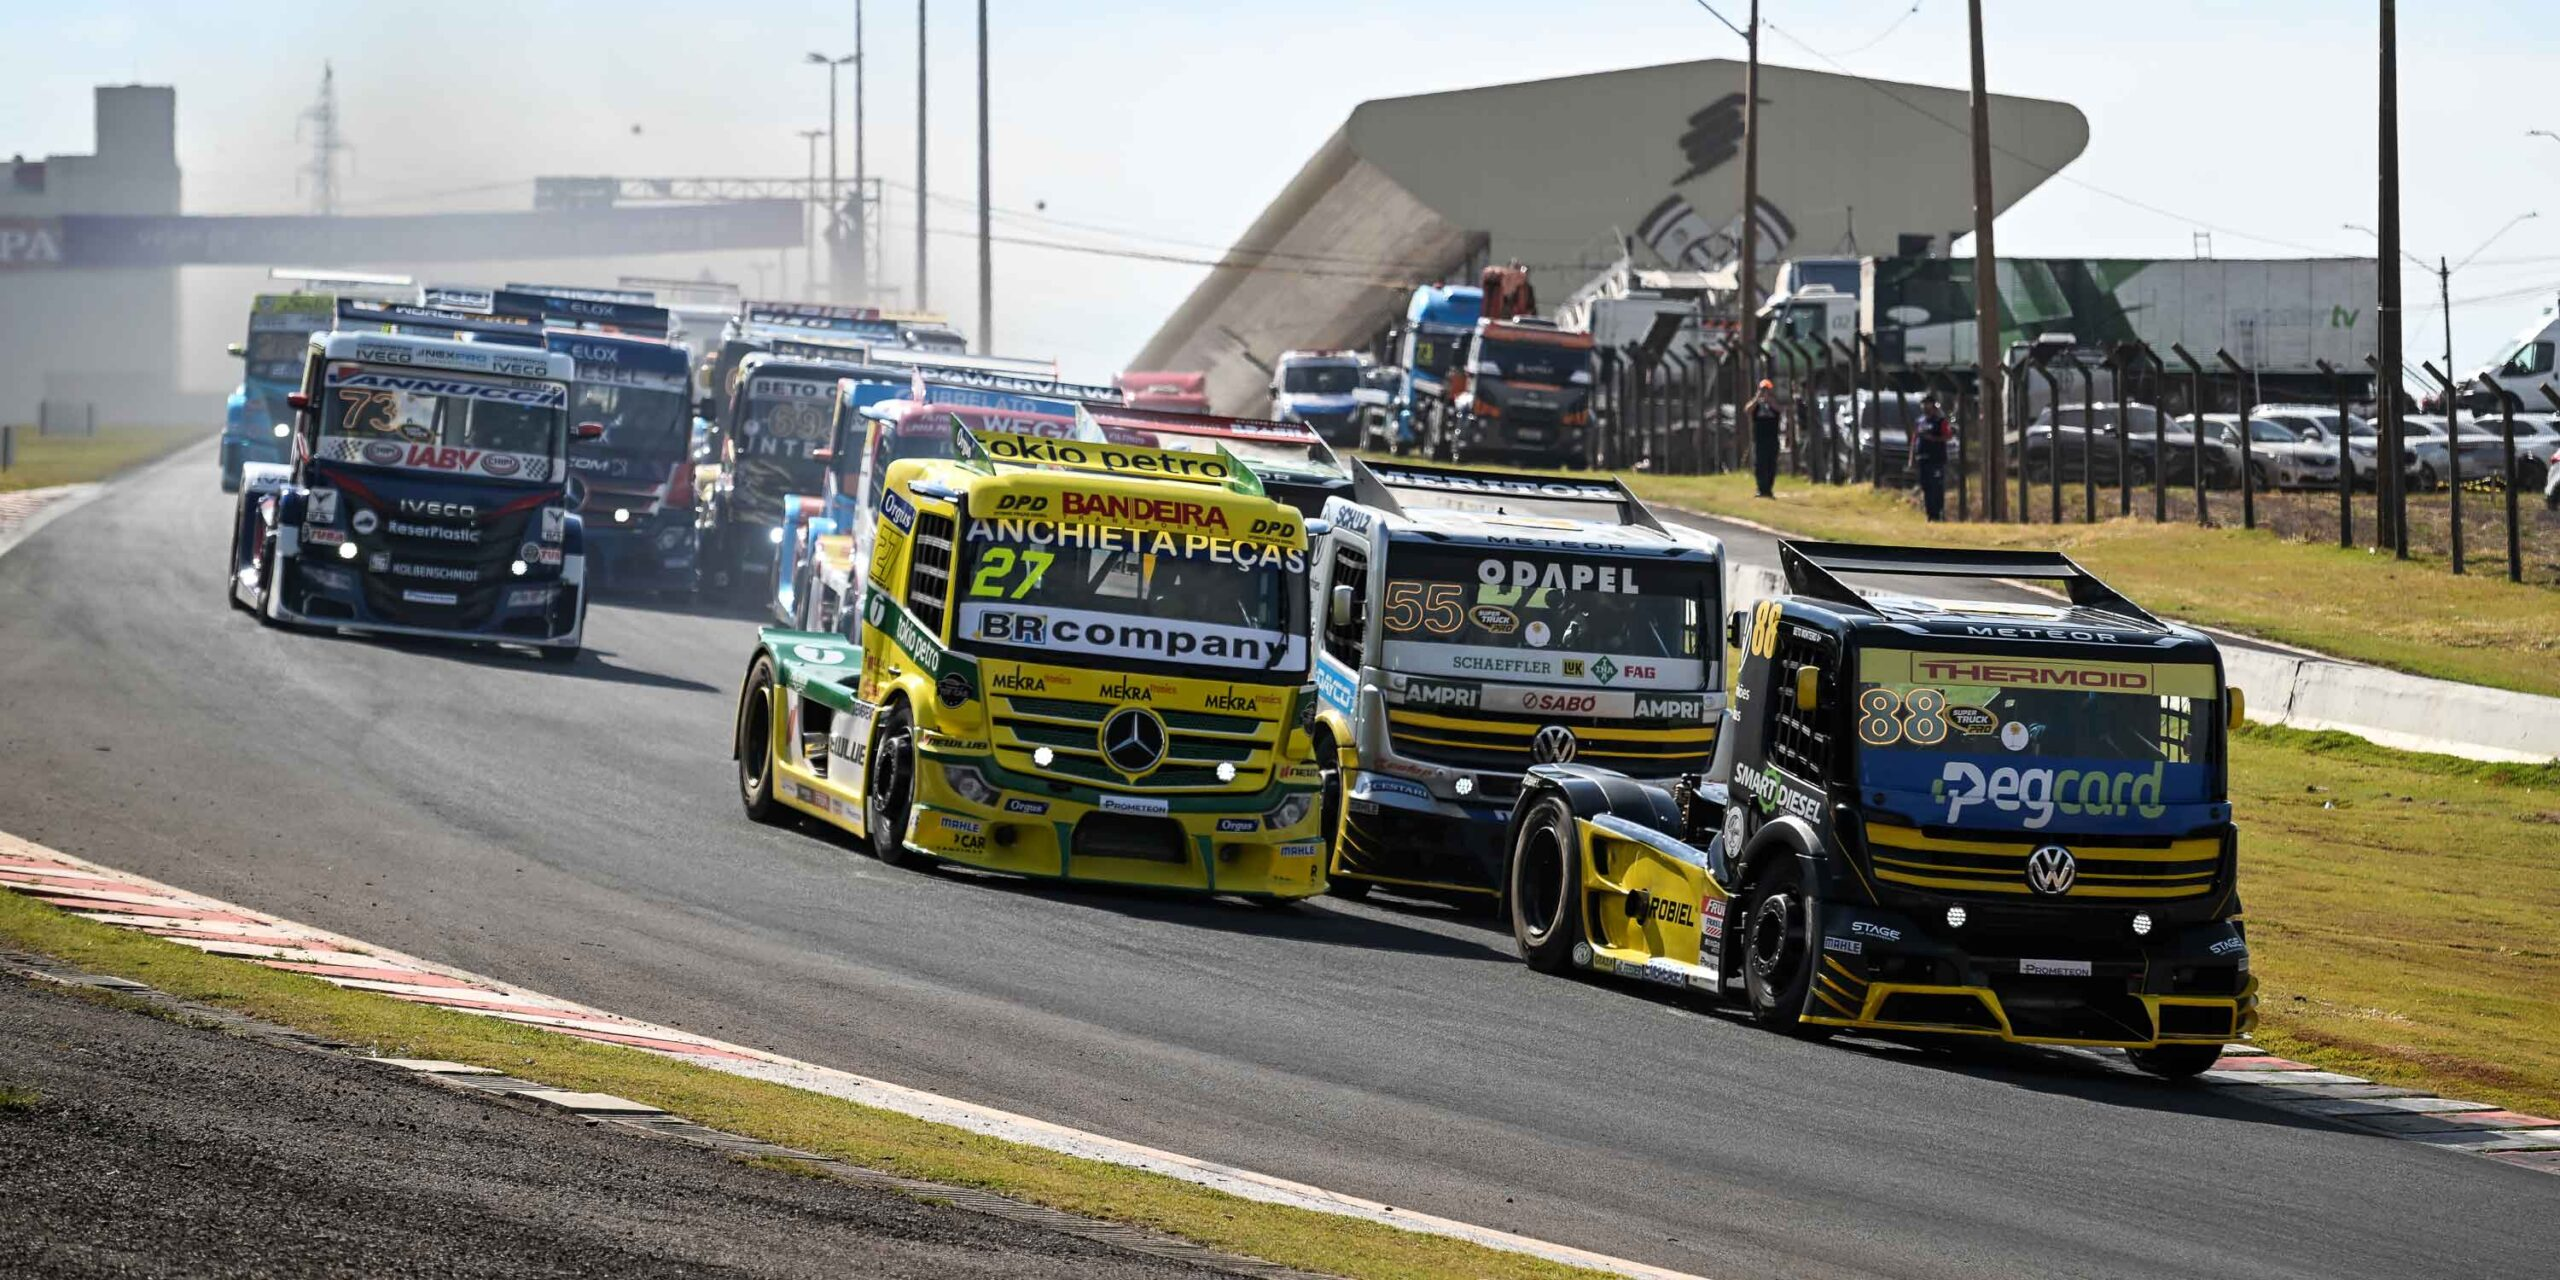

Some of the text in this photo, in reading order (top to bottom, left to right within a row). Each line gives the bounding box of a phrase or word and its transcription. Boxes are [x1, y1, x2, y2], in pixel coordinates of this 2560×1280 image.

[356, 349, 412, 363] IVECO
[572, 344, 619, 362] ELOX
[492, 362, 547, 377] IVECO
[755, 380, 817, 398] BETO
[338, 388, 400, 432] 73
[1101, 447, 1228, 479] petro
[400, 499, 475, 519] IVECO
[884, 494, 914, 529] Orgus
[996, 494, 1049, 512] DPD
[1062, 491, 1229, 530] BANDEIRA
[1250, 519, 1295, 538] DPD
[1335, 505, 1372, 534] SCHULZ
[388, 519, 481, 543] ReserPlastic
[966, 518, 1305, 574] ANCHIETA PEÇAS
[1486, 535, 1626, 551] METEOR
[392, 563, 479, 582] KOLBENSCHMIDT
[969, 547, 1056, 600] 27
[1477, 558, 1640, 595] ODAPEL
[1384, 581, 1464, 633] 55
[1481, 615, 1511, 625] TRUCK
[1751, 600, 1783, 660] 88
[897, 614, 940, 672] tokio petro
[1966, 625, 2117, 643] METEOR
[1452, 656, 1551, 675] SCHAEFFLER
[1623, 665, 1656, 679] FAG
[1919, 660, 2148, 689] THERMOID
[992, 664, 1046, 692] MEKRA
[1100, 674, 1152, 701] MEKRA
[1204, 685, 1257, 712] MEKRA
[1406, 683, 1476, 708] AMPRI
[1634, 699, 1700, 719] AMPRI
[1858, 687, 1948, 745] 88
[1957, 715, 1989, 724] TRUCK
[1734, 761, 1778, 800] SMART
[1777, 784, 1821, 825] DIESEL
[1010, 800, 1043, 813] Orgus
[941, 816, 980, 833] MAHLE
[1221, 819, 1253, 832] Orgus
[1280, 846, 1315, 856] MAHLE
[1650, 897, 1694, 928] ROBIEL
[1851, 921, 1901, 940] STAGE
[1824, 937, 1861, 953] MAHLE
[2209, 937, 2244, 954] STAGE
